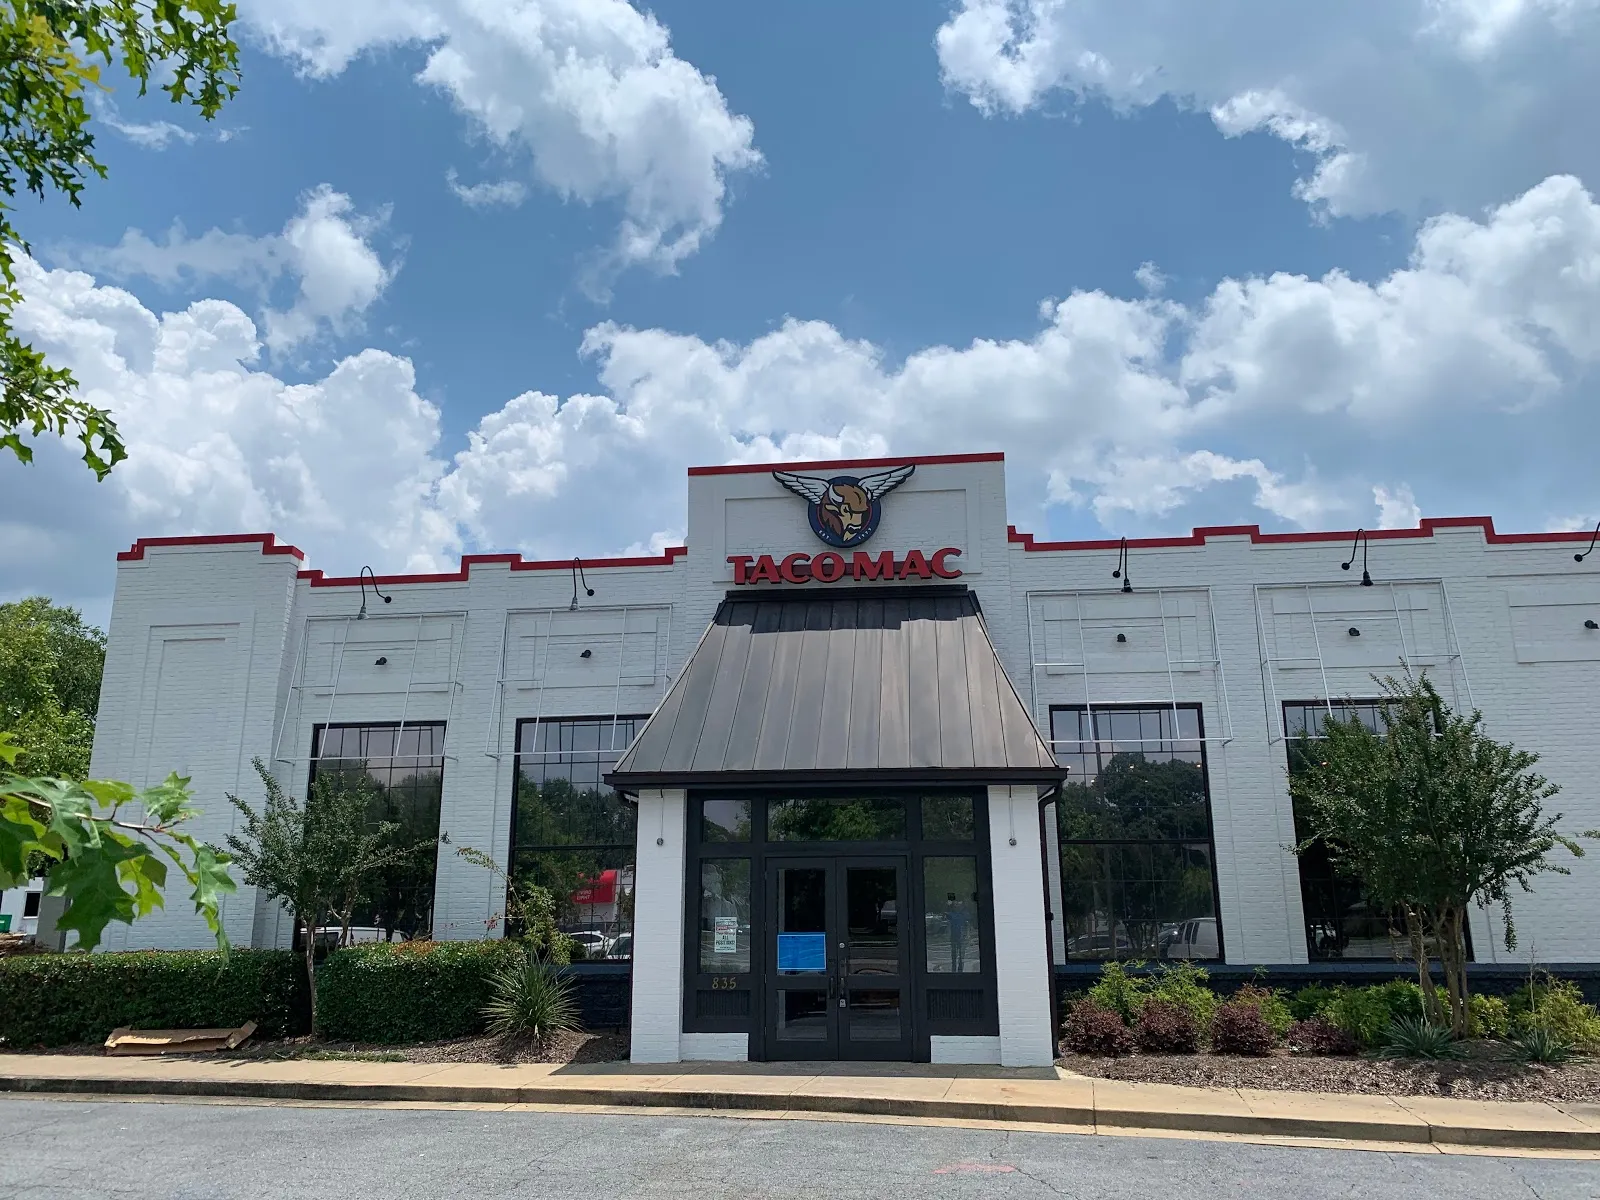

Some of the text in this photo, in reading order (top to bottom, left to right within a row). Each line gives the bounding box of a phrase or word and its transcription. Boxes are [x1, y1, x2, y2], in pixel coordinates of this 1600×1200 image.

[726, 547, 963, 586] TACO MAC
[712, 977, 737, 990] 835
